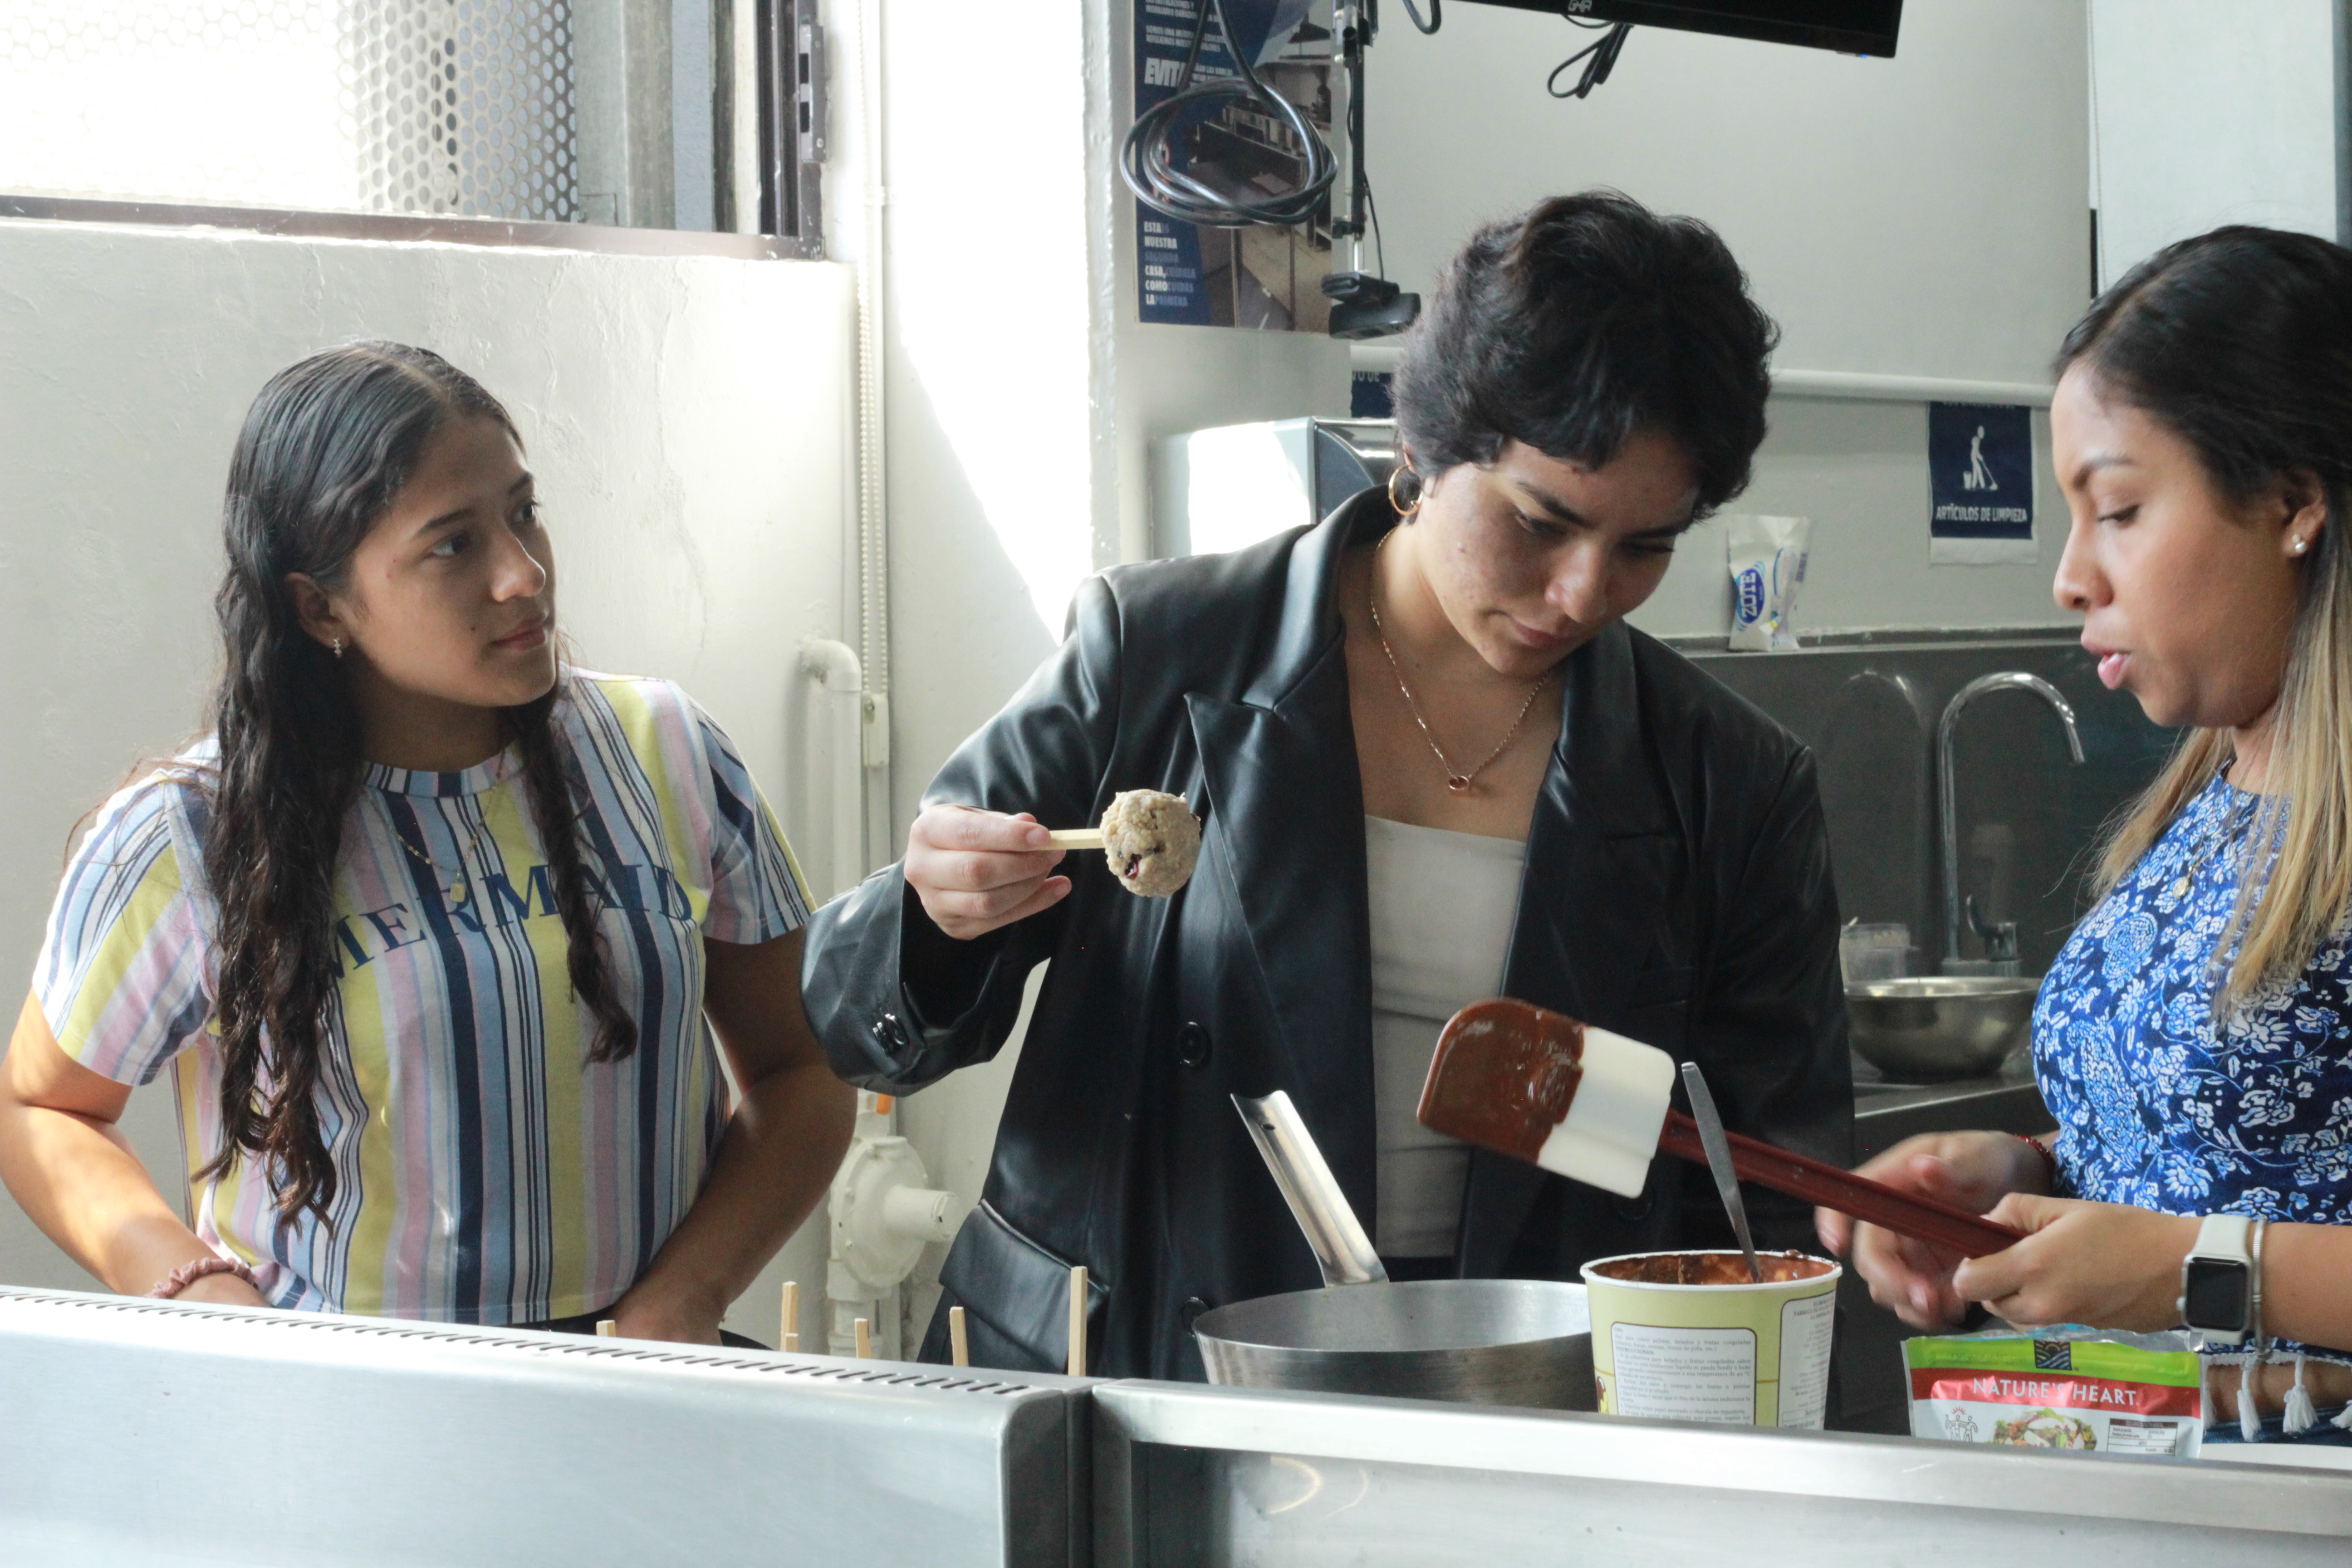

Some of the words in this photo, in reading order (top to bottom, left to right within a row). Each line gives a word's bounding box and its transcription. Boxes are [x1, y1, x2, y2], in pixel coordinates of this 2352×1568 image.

[1144, 221, 1161, 233] ESTA
[1145, 235, 1177, 249] NUESTRA
[1145, 265, 1166, 279] CASA,
[1145, 280, 1168, 291] COMO
[1146, 294, 1155, 305] LA
[1936, 503, 1979, 521] ARTÍCULOS
[1981, 507, 1991, 521] DE
[1993, 506, 2028, 522] LIMPIEZA
[1740, 572, 1758, 618] ZOTE
[1973, 1378, 2064, 1399] NATURE'S
[2073, 1386, 2138, 1406] HEART
